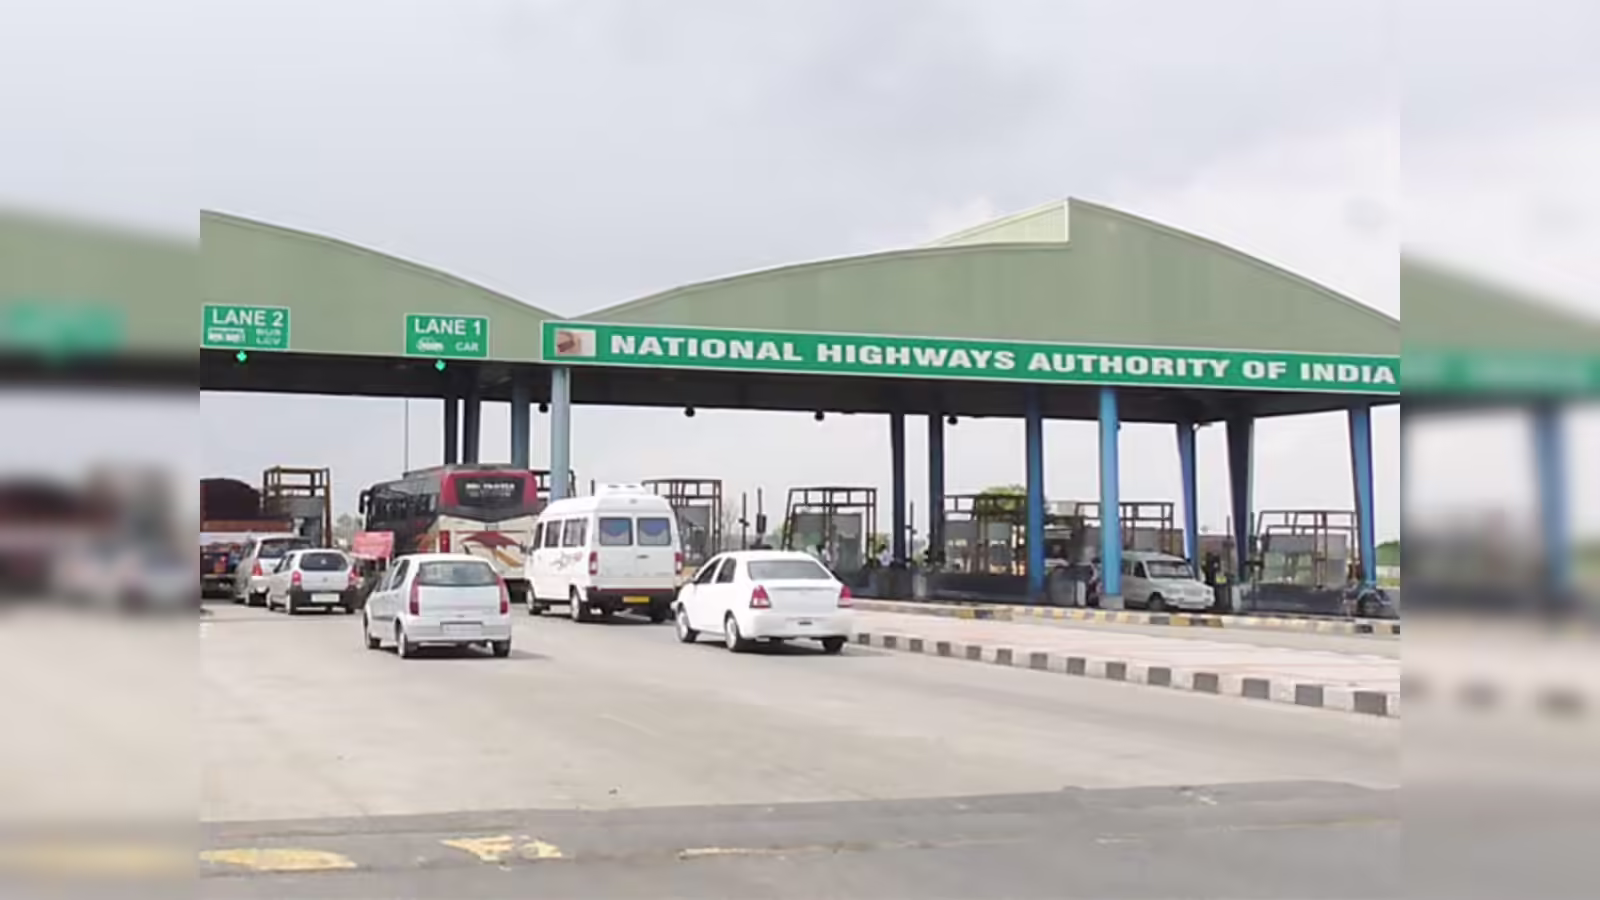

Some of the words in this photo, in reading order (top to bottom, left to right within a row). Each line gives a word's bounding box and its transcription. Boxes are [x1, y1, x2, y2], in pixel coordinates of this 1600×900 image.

[212, 307, 267, 327] LANE
[271, 311, 284, 328] 2
[414, 317, 466, 336] LANE
[472, 320, 482, 336] 1
[455, 341, 480, 353] CAR
[610, 335, 803, 362] NATIONAL
[816, 344, 1016, 371] HIGHWAYS
[1028, 352, 1230, 378] AUTHORITY
[1242, 360, 1287, 380] OF
[1300, 363, 1396, 385] INDIA
